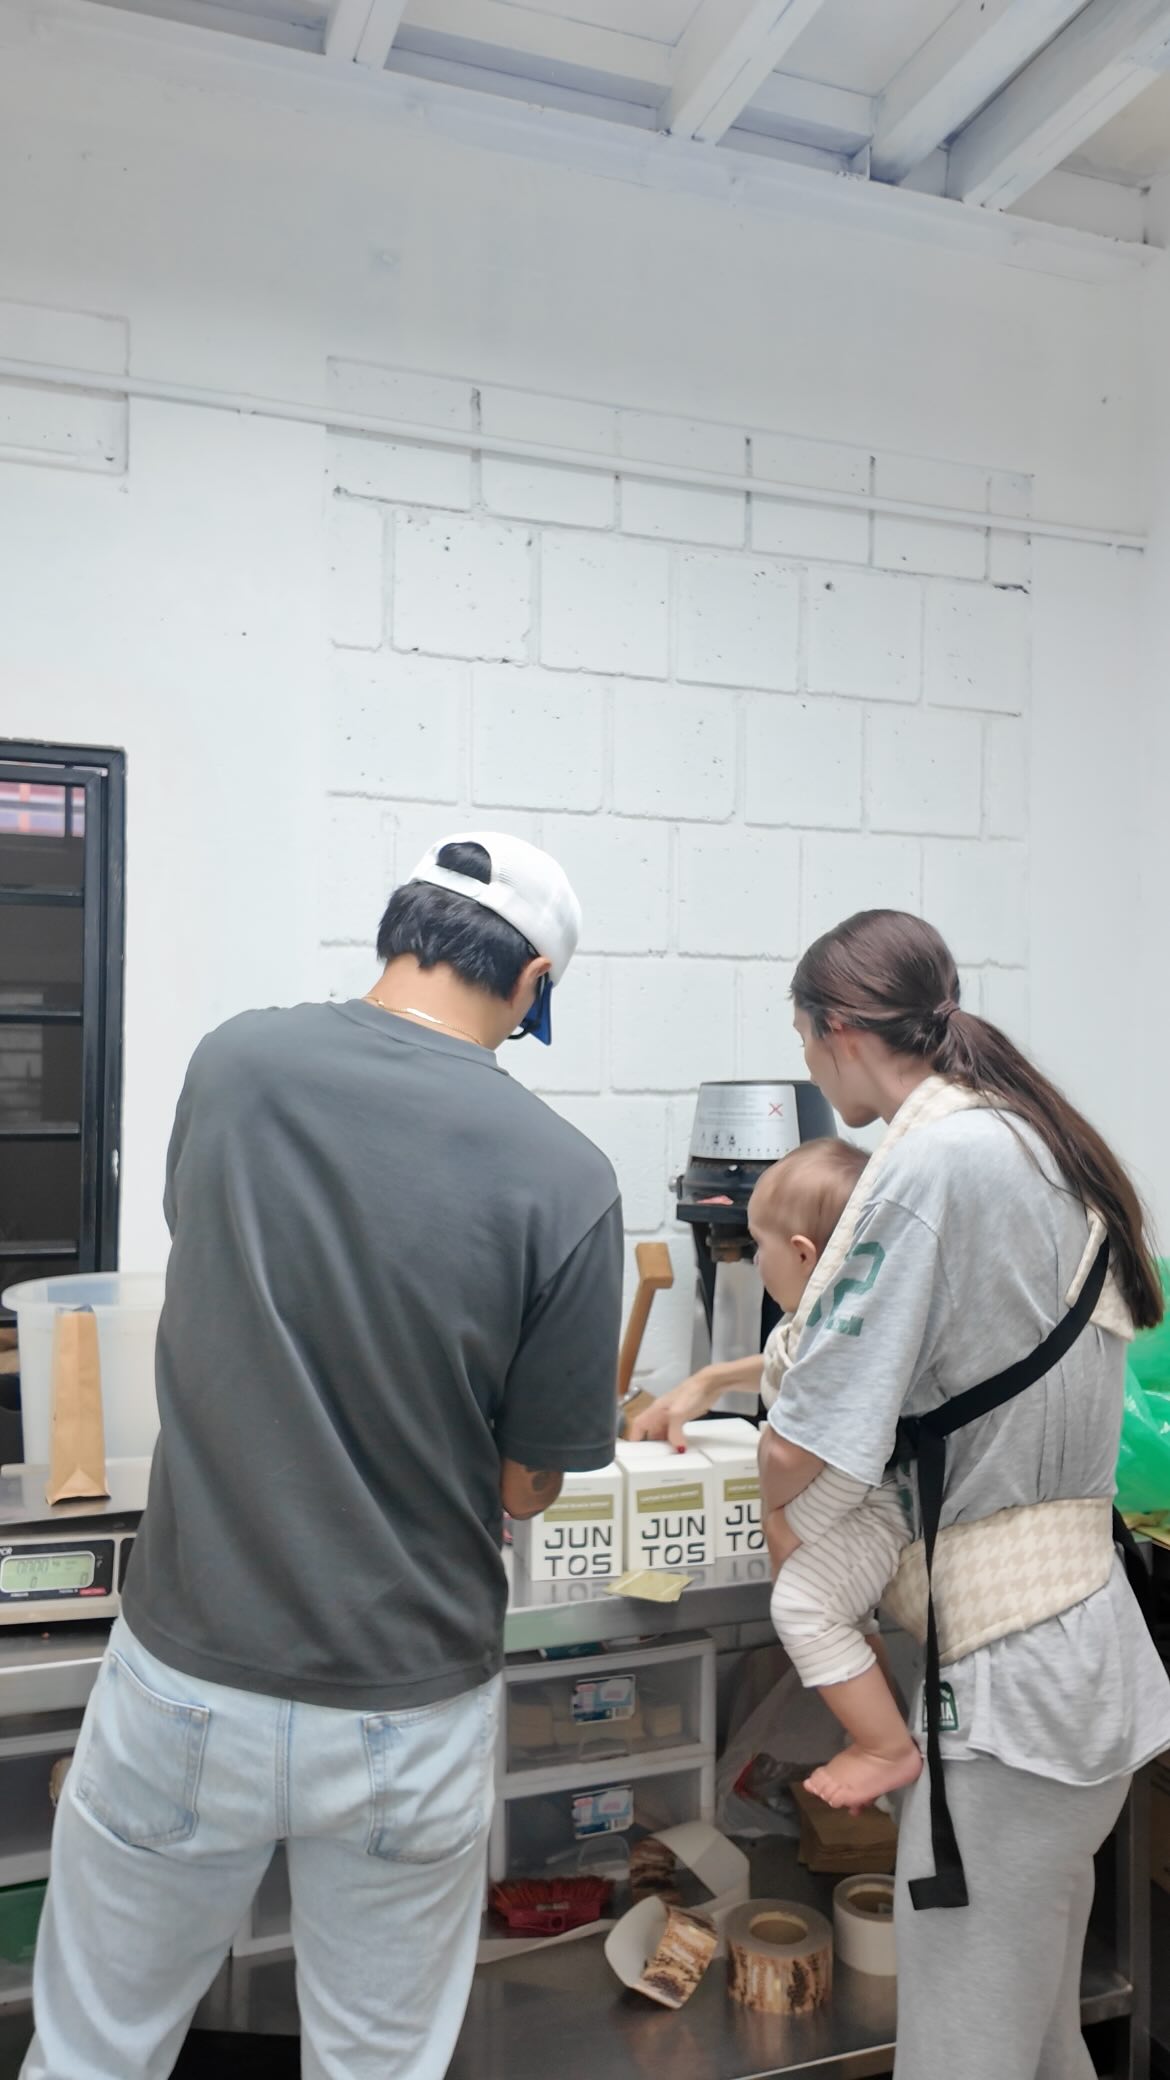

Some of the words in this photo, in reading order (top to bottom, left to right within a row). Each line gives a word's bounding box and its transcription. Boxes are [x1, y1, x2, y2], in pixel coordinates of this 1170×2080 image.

[806, 1241, 886, 1337] 2
[725, 1504, 761, 1526] JU
[544, 1526, 612, 1550] JUN
[641, 1515, 706, 1540] JUN
[725, 1529, 765, 1552] TO
[544, 1553, 612, 1577] TOS
[641, 1542, 706, 1567] TOS
